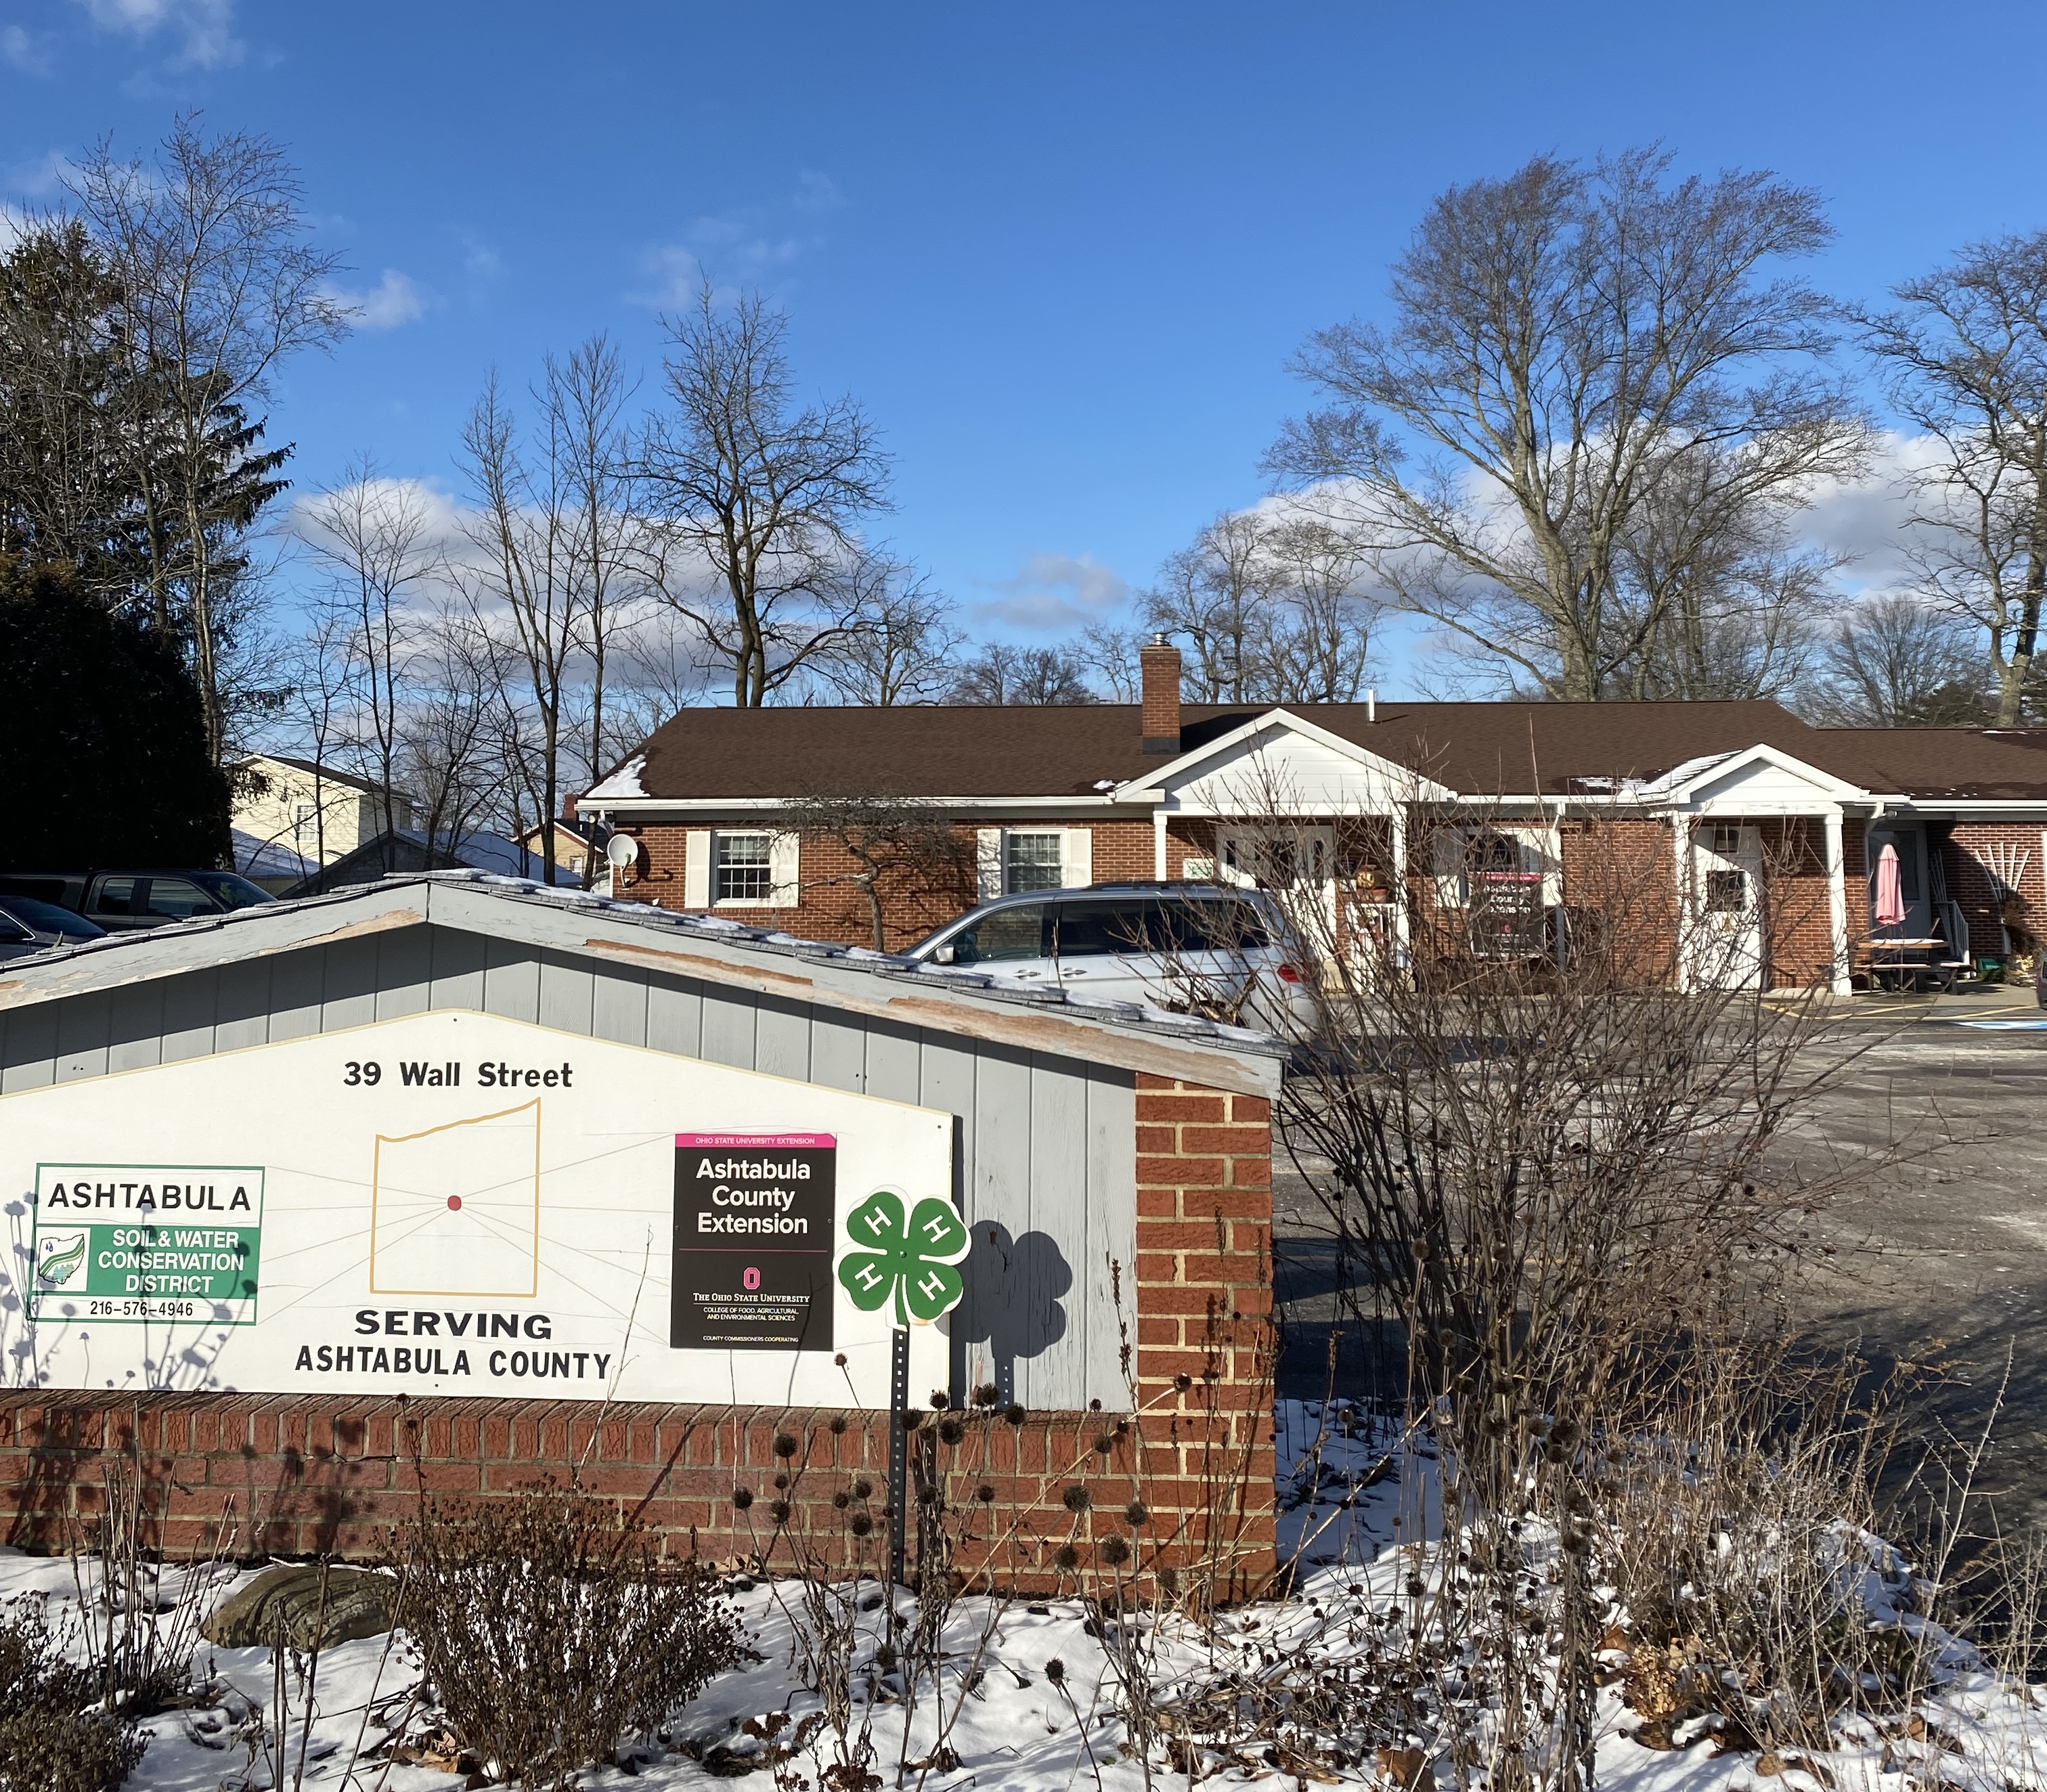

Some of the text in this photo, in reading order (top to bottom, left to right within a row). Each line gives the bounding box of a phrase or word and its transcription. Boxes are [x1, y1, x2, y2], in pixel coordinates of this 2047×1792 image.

[343, 1062, 573, 1088] 39 Wall Street
[696, 1158, 811, 1179] Ashtabula
[47, 1182, 251, 1210] ASHTABULA
[712, 1185, 795, 1212] County
[698, 1212, 808, 1234] Extension
[863, 1206, 951, 1244] H H
[112, 1229, 239, 1248] SOIL & WATER
[97, 1251, 244, 1271] CONSERVATION
[125, 1275, 214, 1293] DISTRICT
[743, 1267, 761, 1290] O
[854, 1262, 946, 1301] H H
[90, 1301, 193, 1316] 216-576-4946
[693, 1292, 810, 1303] THE OHIO STATE UNIVERSITY
[355, 1310, 552, 1340] SERVING
[294, 1345, 611, 1380] ASHTABULA COUNTY
